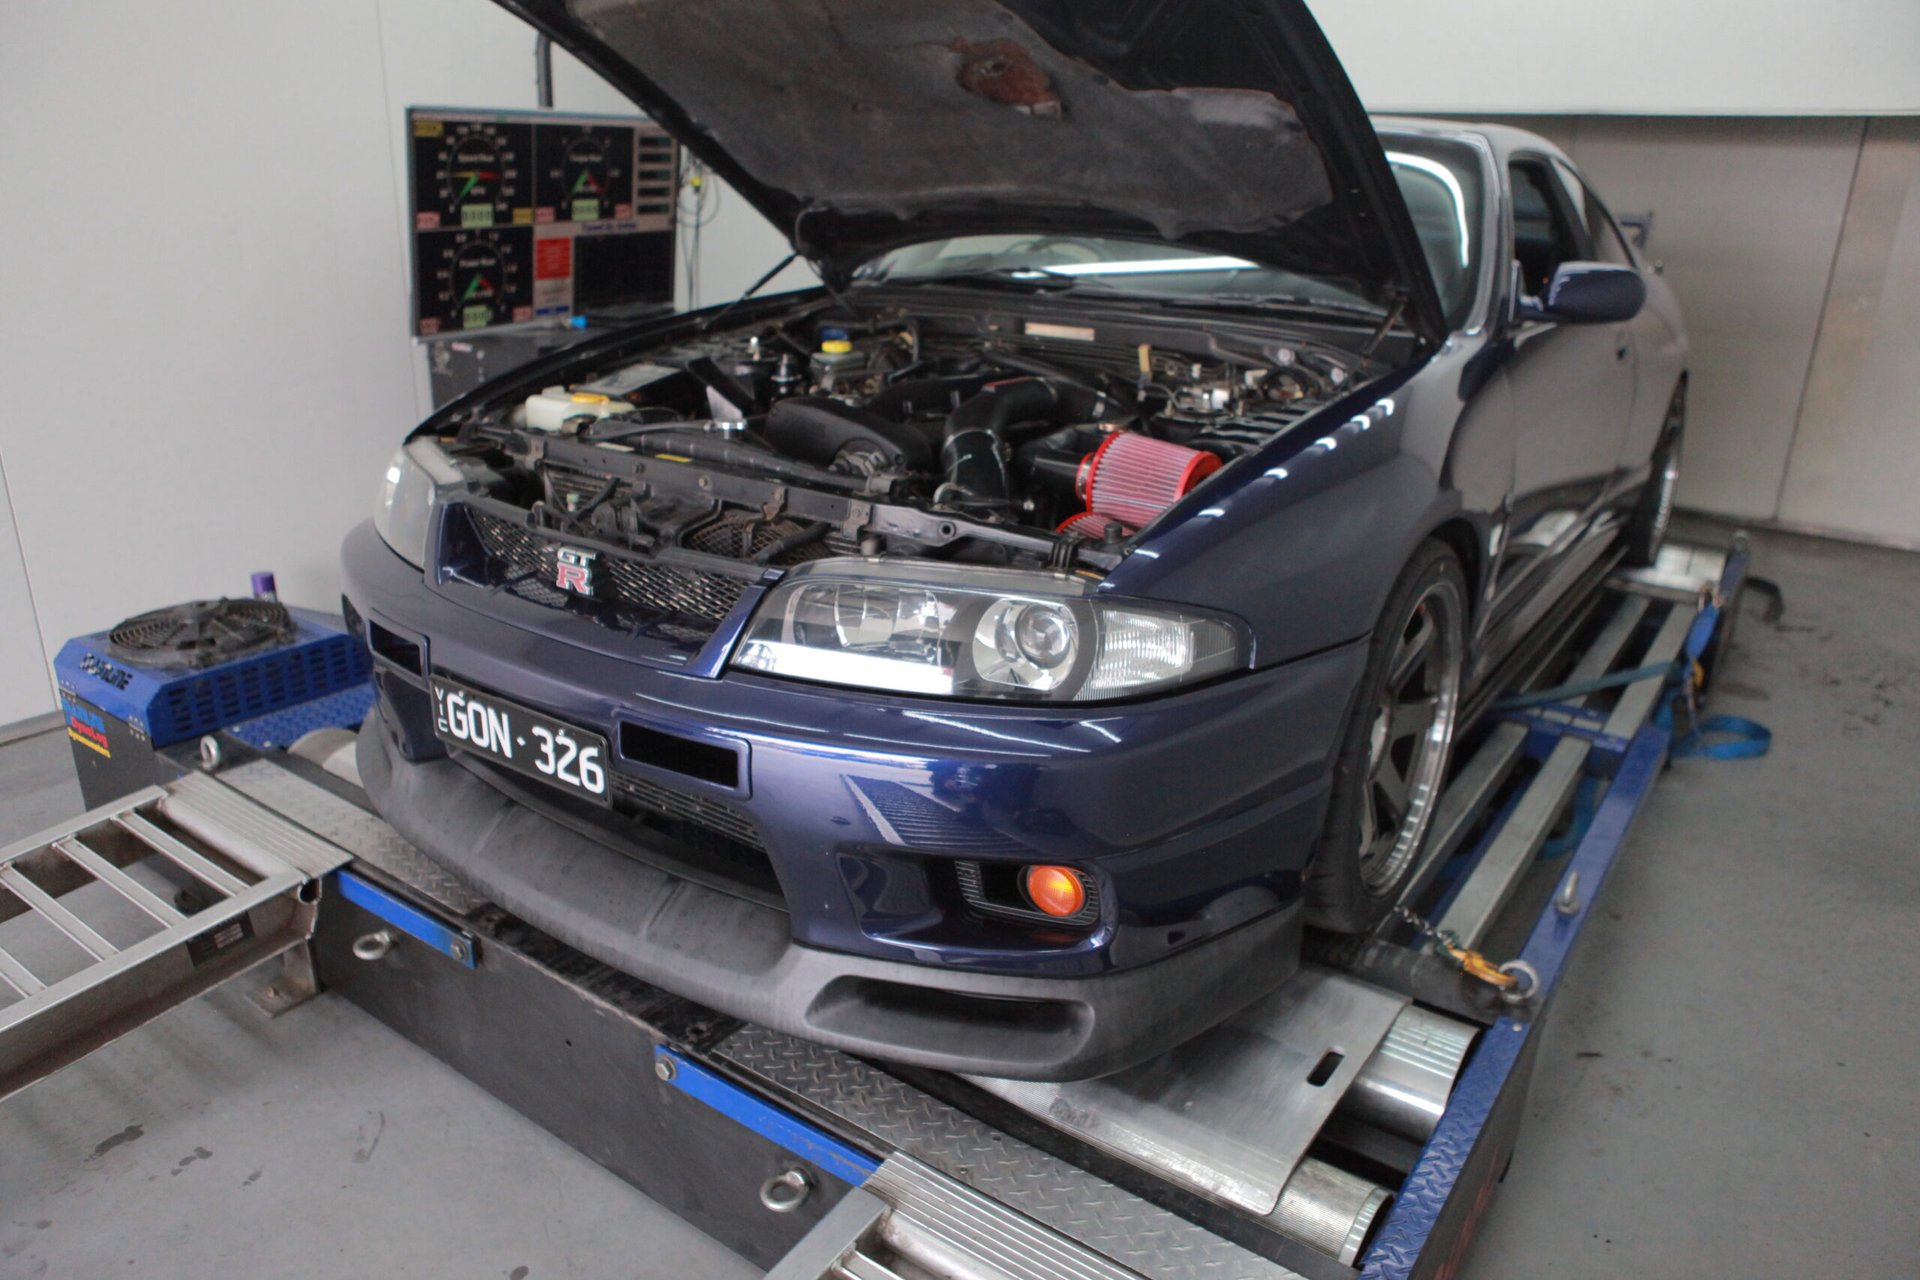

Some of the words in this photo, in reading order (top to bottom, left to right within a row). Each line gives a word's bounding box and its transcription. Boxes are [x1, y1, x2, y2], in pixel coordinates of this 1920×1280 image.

[557, 547, 596, 567] GT
[556, 561, 594, 596] R
[434, 686, 449, 733] VIC
[447, 692, 513, 759] GON
[531, 726, 605, 795] 326
